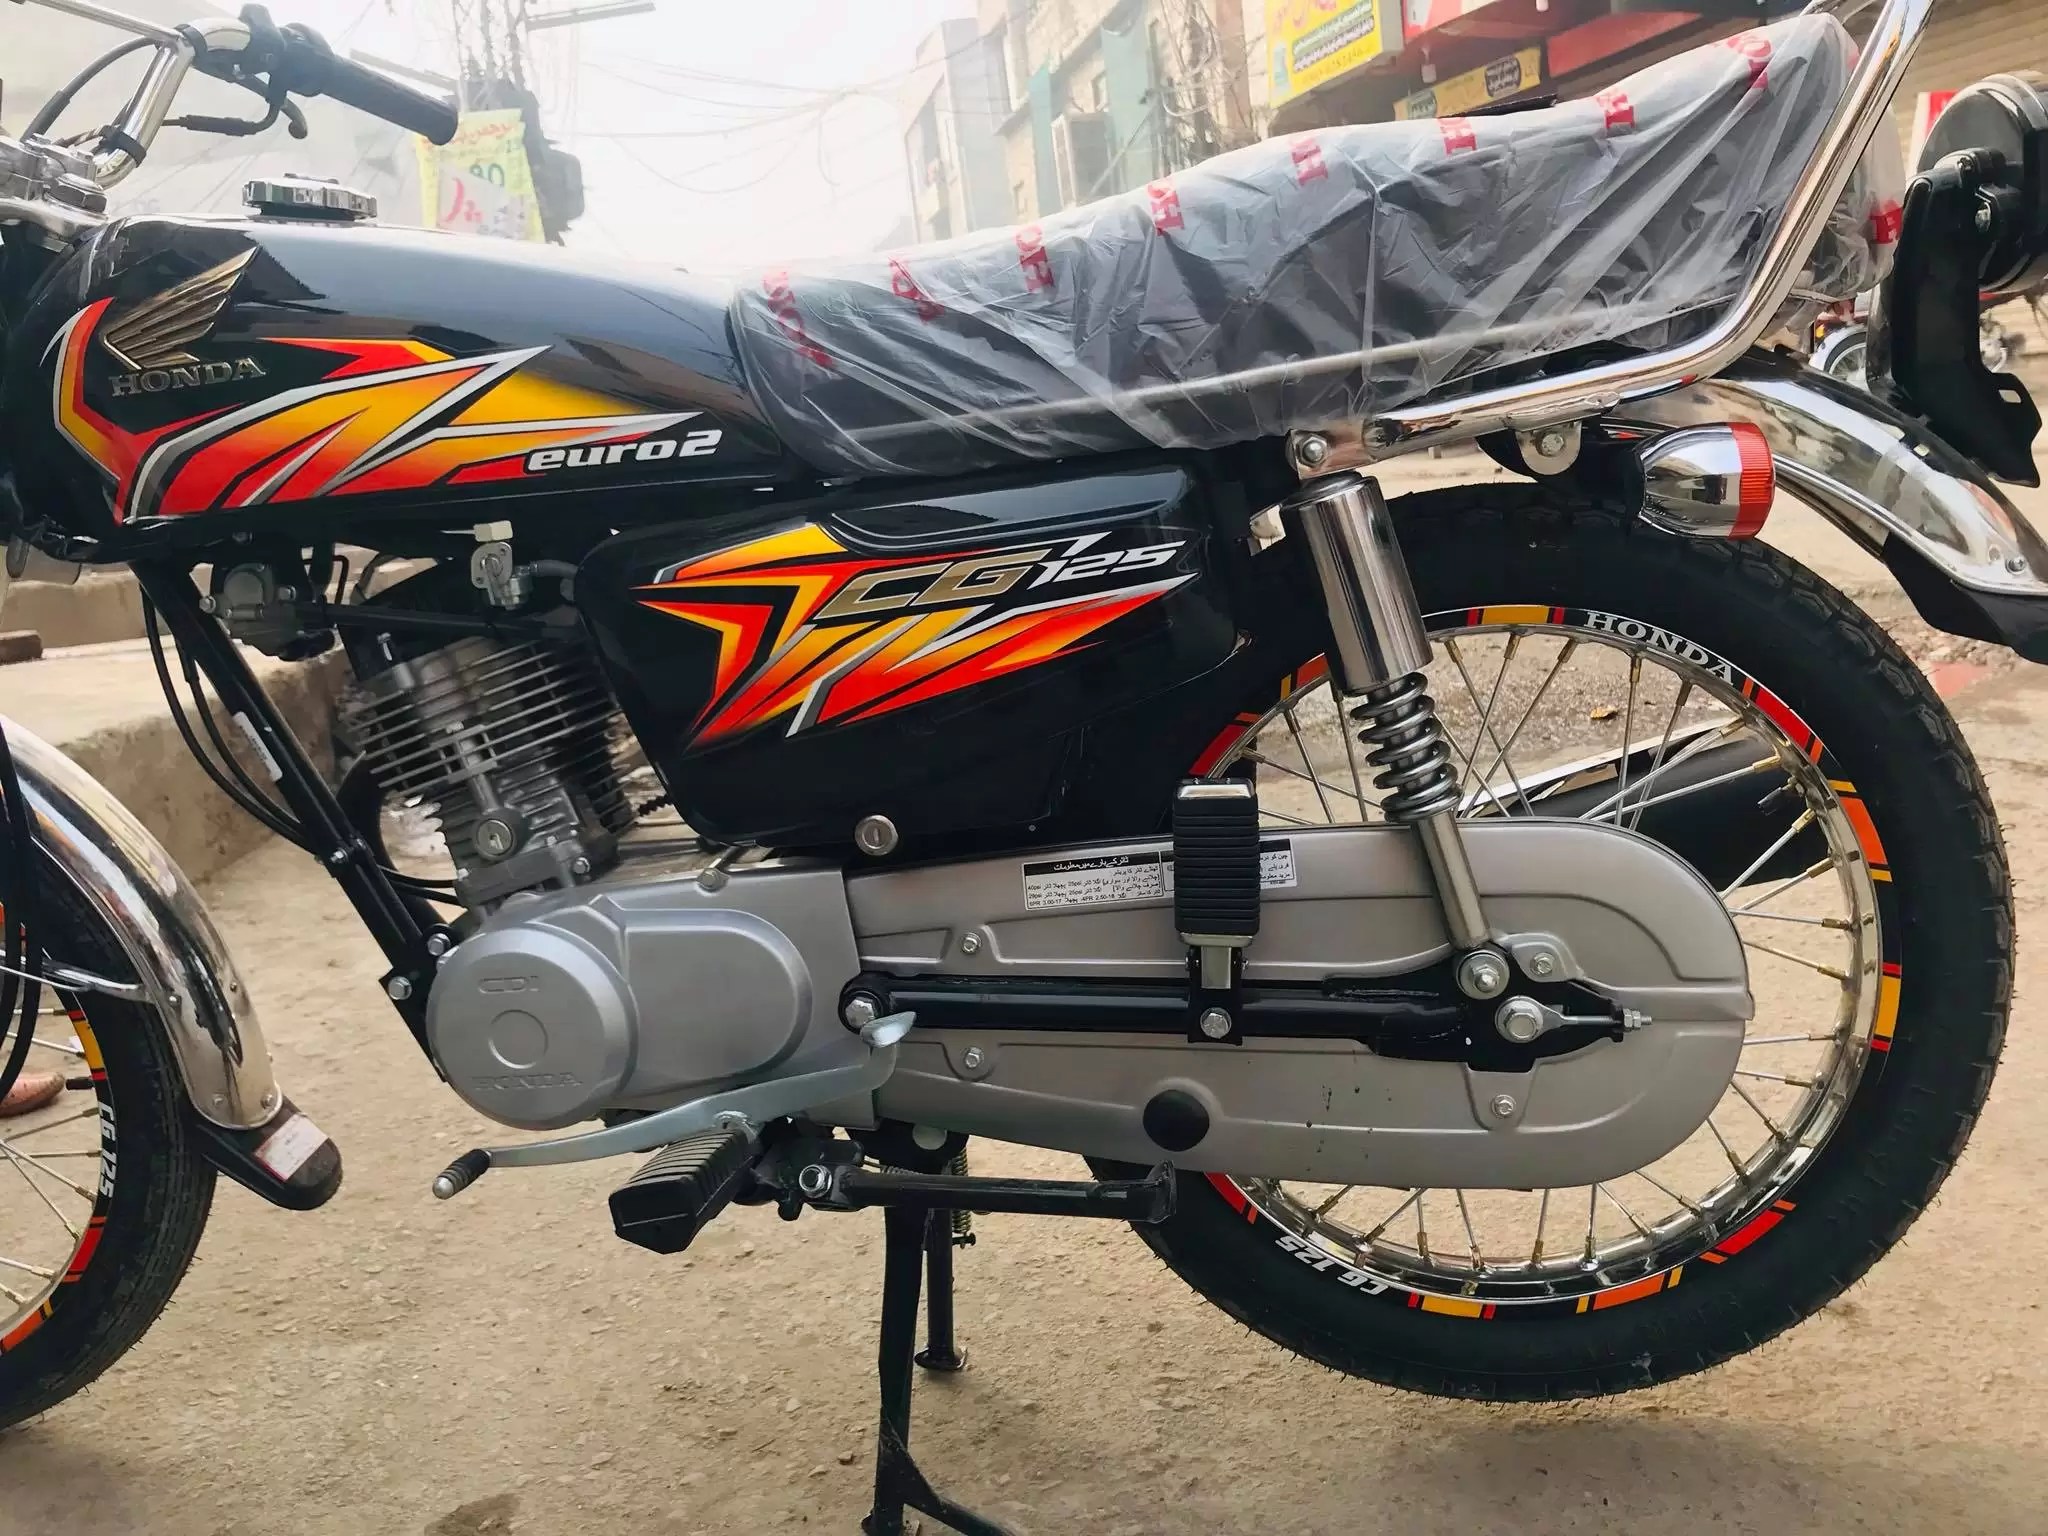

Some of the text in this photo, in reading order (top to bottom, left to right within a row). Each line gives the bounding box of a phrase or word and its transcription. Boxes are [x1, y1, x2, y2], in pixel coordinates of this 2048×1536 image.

[108, 357, 267, 397] HONDA
[1027, 540, 1187, 590] 125
[1583, 611, 1734, 686] HONDA
[99, 1101, 117, 1198] CG 125
[1275, 1235, 1389, 1296] CG 125
